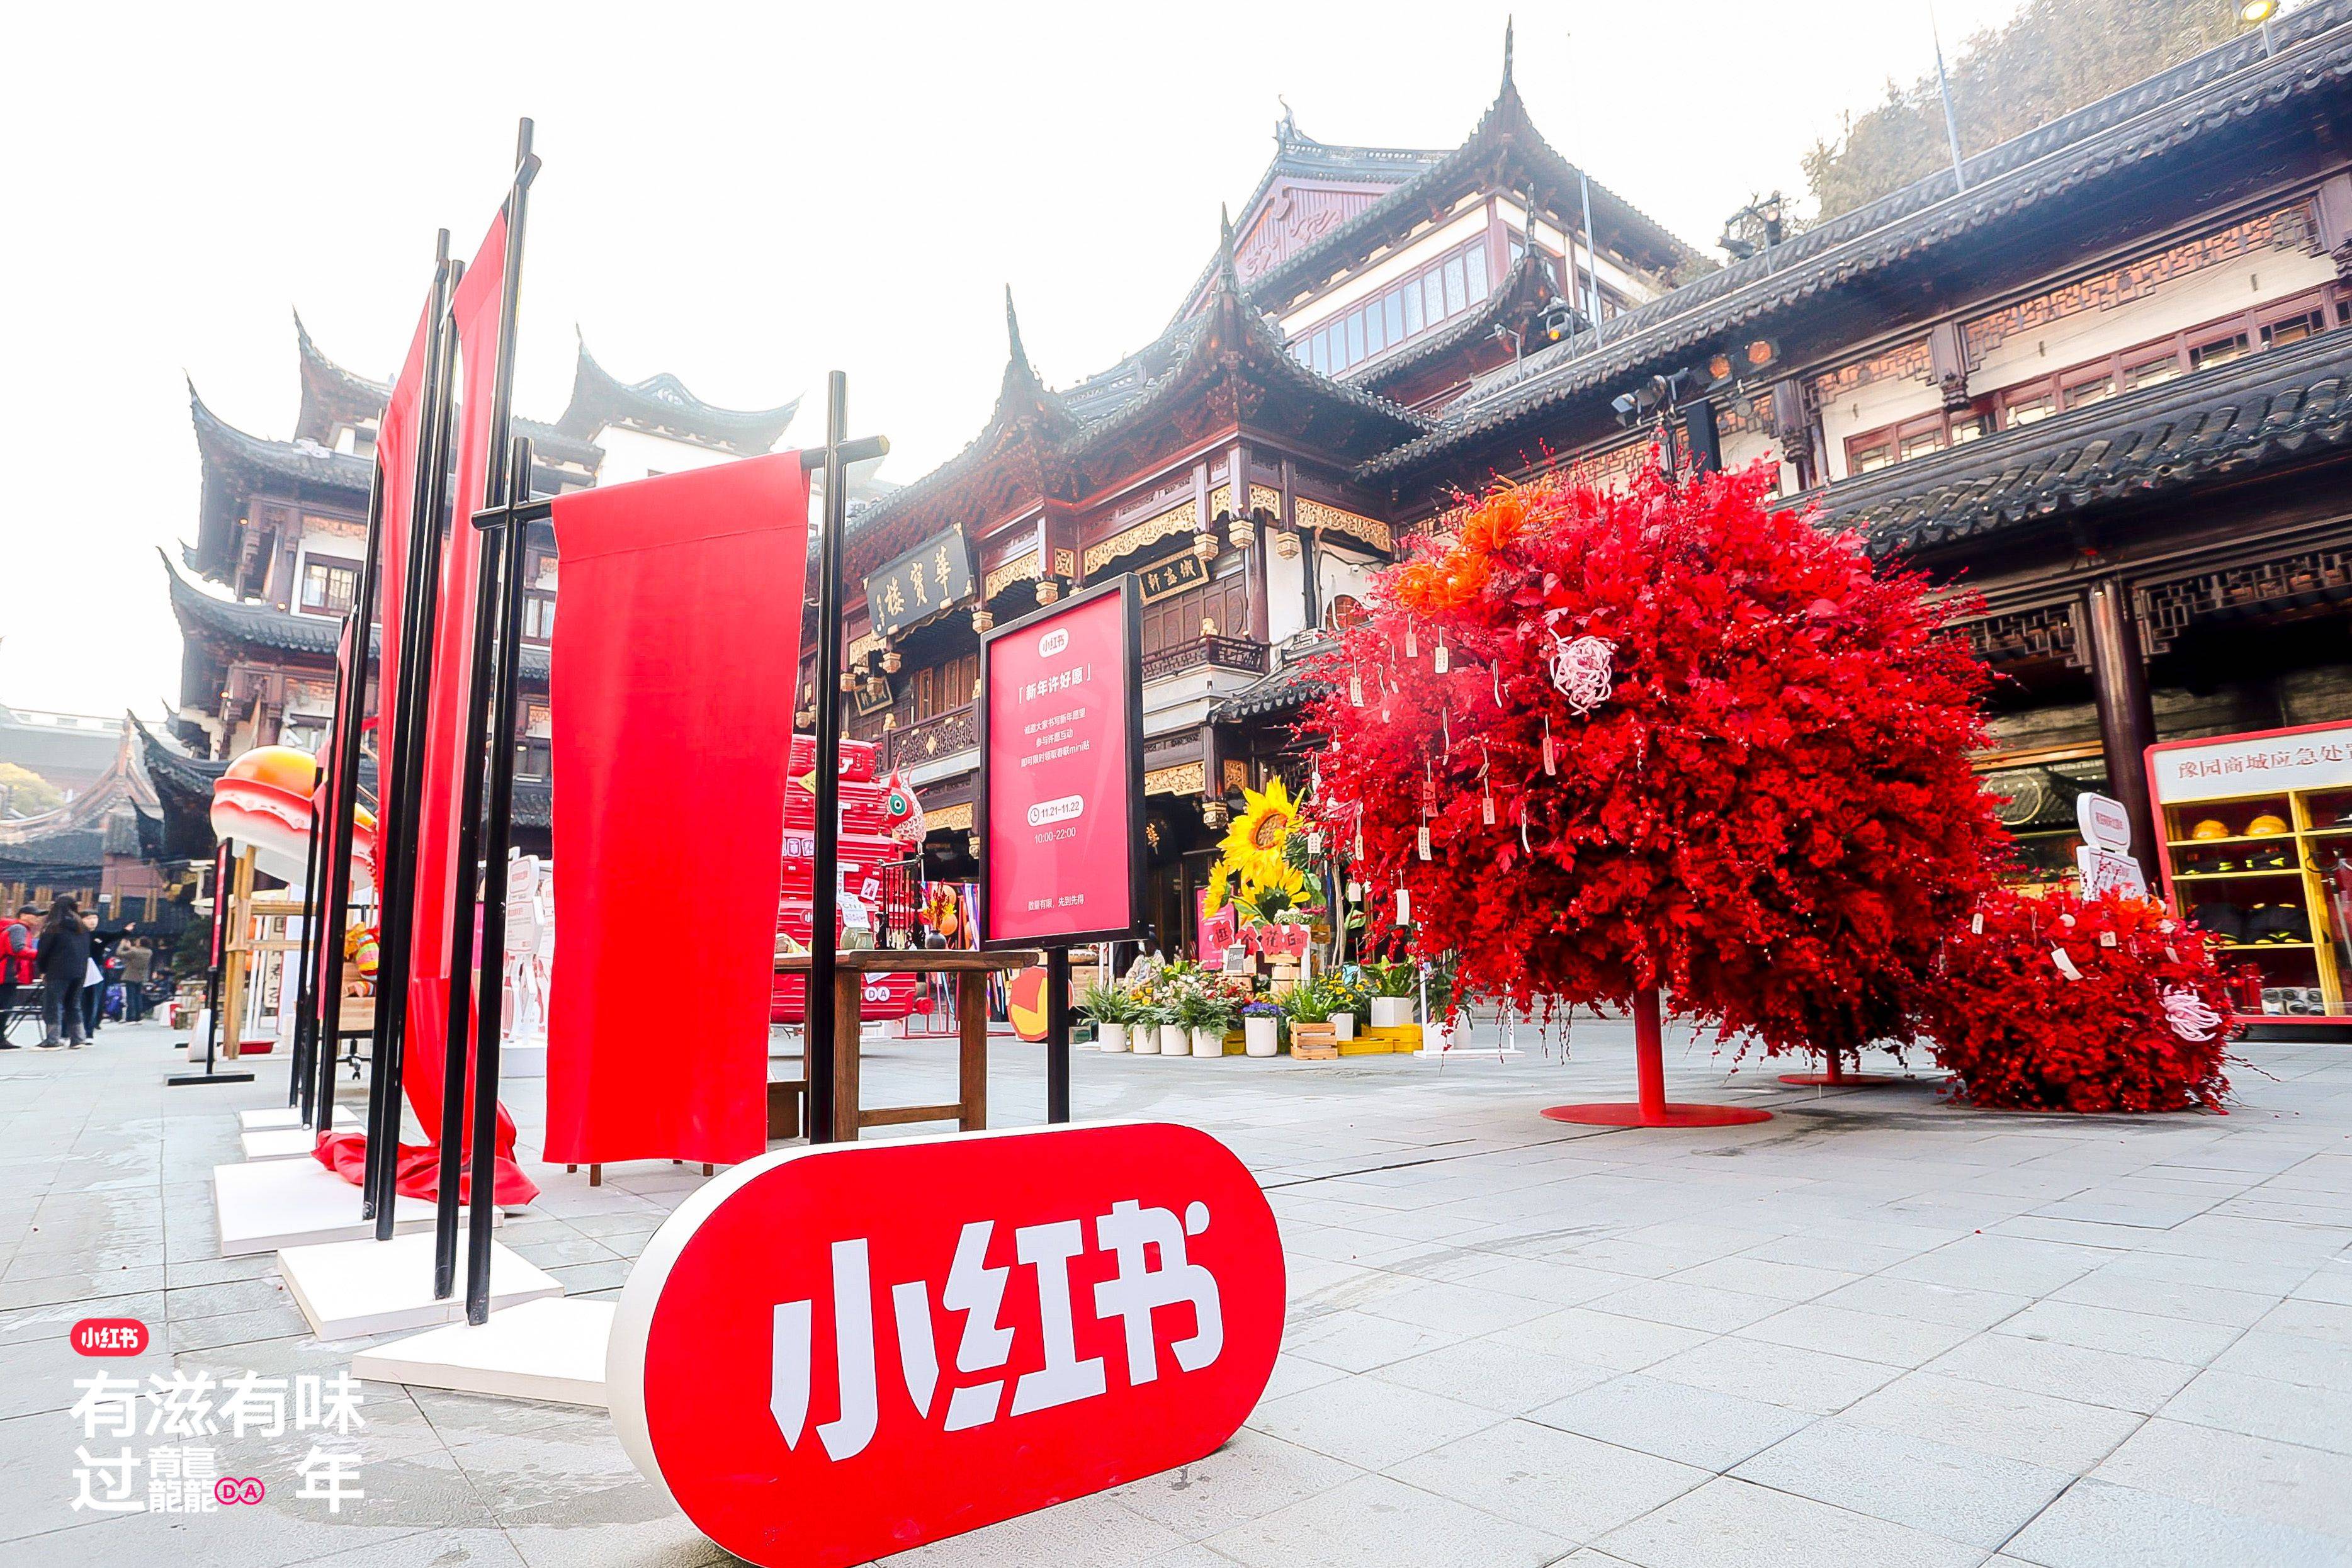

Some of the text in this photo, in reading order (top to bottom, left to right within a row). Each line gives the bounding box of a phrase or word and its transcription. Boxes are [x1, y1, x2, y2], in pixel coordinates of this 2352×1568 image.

[1043, 634, 1065, 651] 小红书
[1036, 728, 1073, 748] 参与许愿互动
[1041, 801, 1080, 818] 11.21-11.22
[1034, 826, 1077, 844] 10:00-22:00
[869, 990, 887, 998] DA
[769, 1199, 1224, 1462] 小红书
